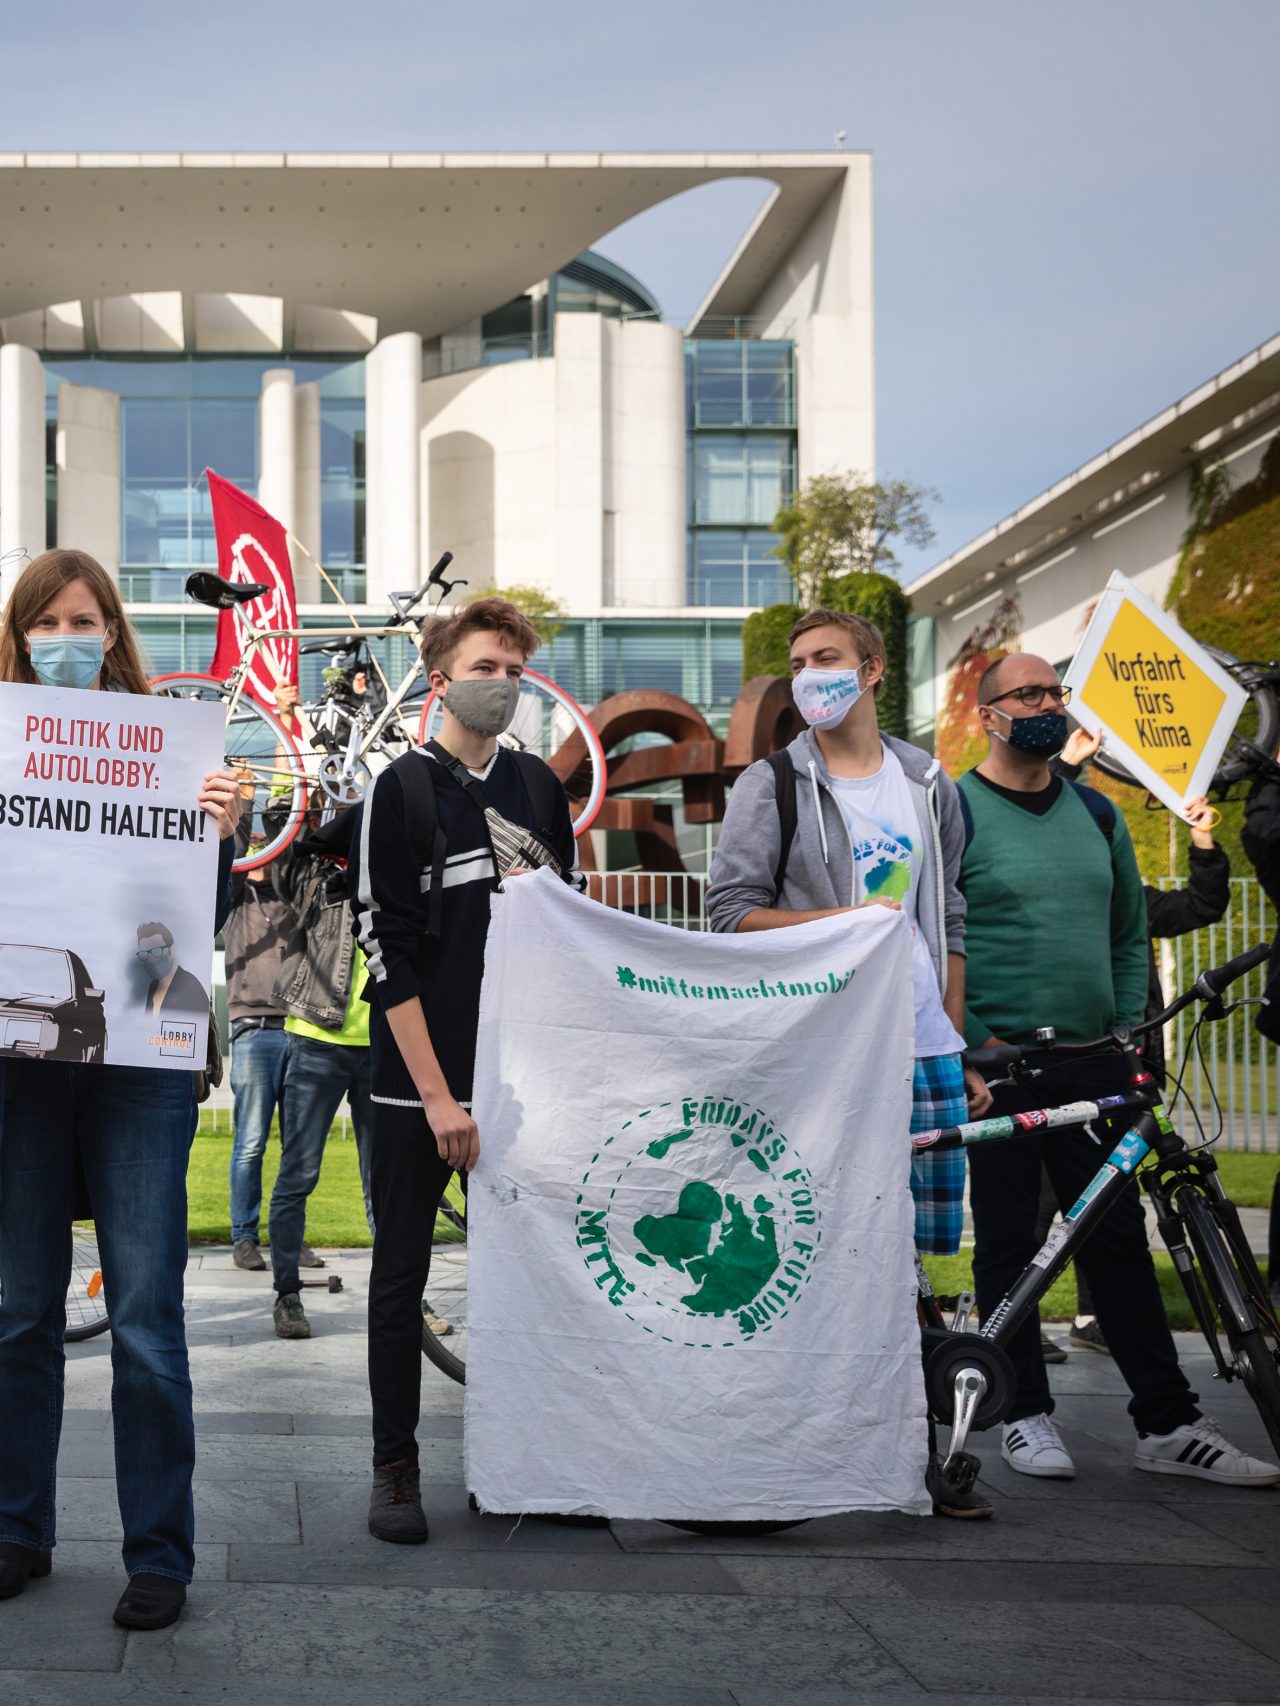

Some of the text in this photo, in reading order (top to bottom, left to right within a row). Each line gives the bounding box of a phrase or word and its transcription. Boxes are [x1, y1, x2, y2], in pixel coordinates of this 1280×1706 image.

[1104, 652, 1185, 682] Vorfahrt
[1133, 686, 1175, 714] fürs
[25, 715, 164, 753] POLITIK UND
[1134, 717, 1191, 748] Klima
[23, 751, 160, 790] AUTOLOBBY:
[101, 802, 206, 843] HALTEN!
[877, 840, 897, 854] FOR
[163, 1030, 193, 1042] LOBBY
[682, 1101, 816, 1335] FRIDAYS FOR FUTURE
[578, 1210, 636, 1307] MITTE
